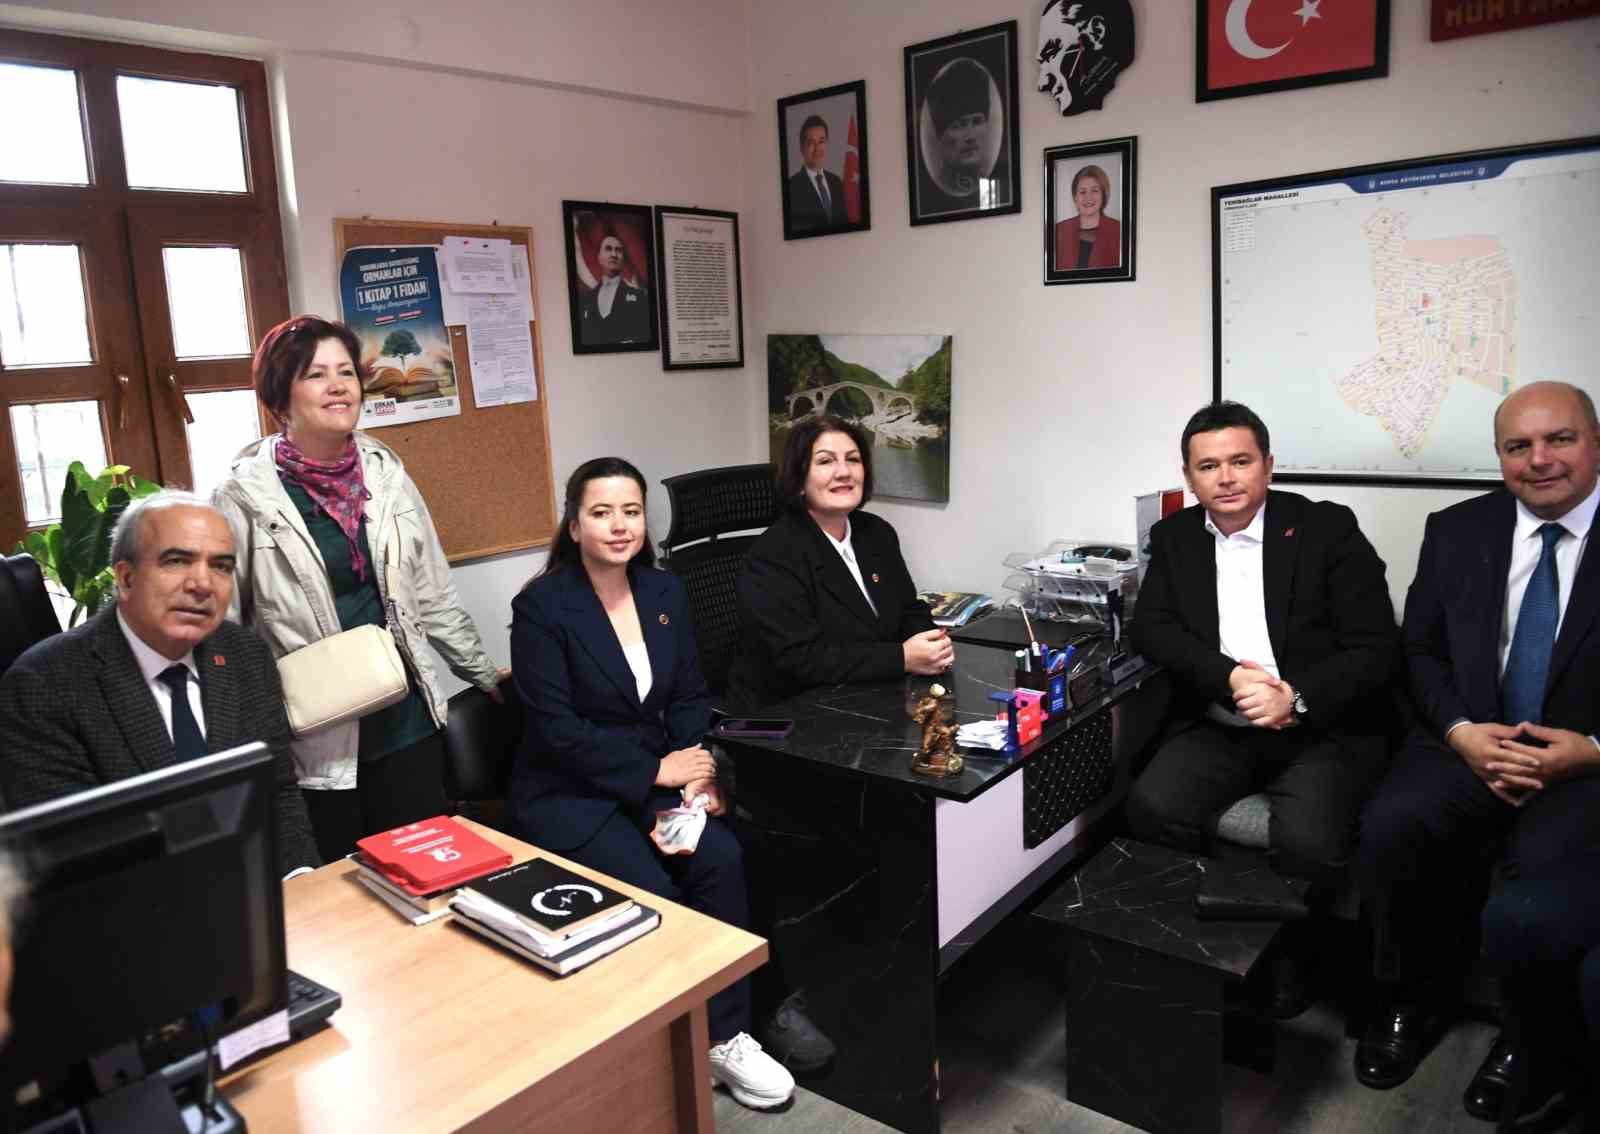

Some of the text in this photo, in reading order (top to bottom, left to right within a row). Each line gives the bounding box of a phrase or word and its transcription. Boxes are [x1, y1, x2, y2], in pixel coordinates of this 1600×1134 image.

[363, 267, 402, 283] ORMANLAR
[358, 280, 427, 304] 1 KİTAP 1 FİDAN
